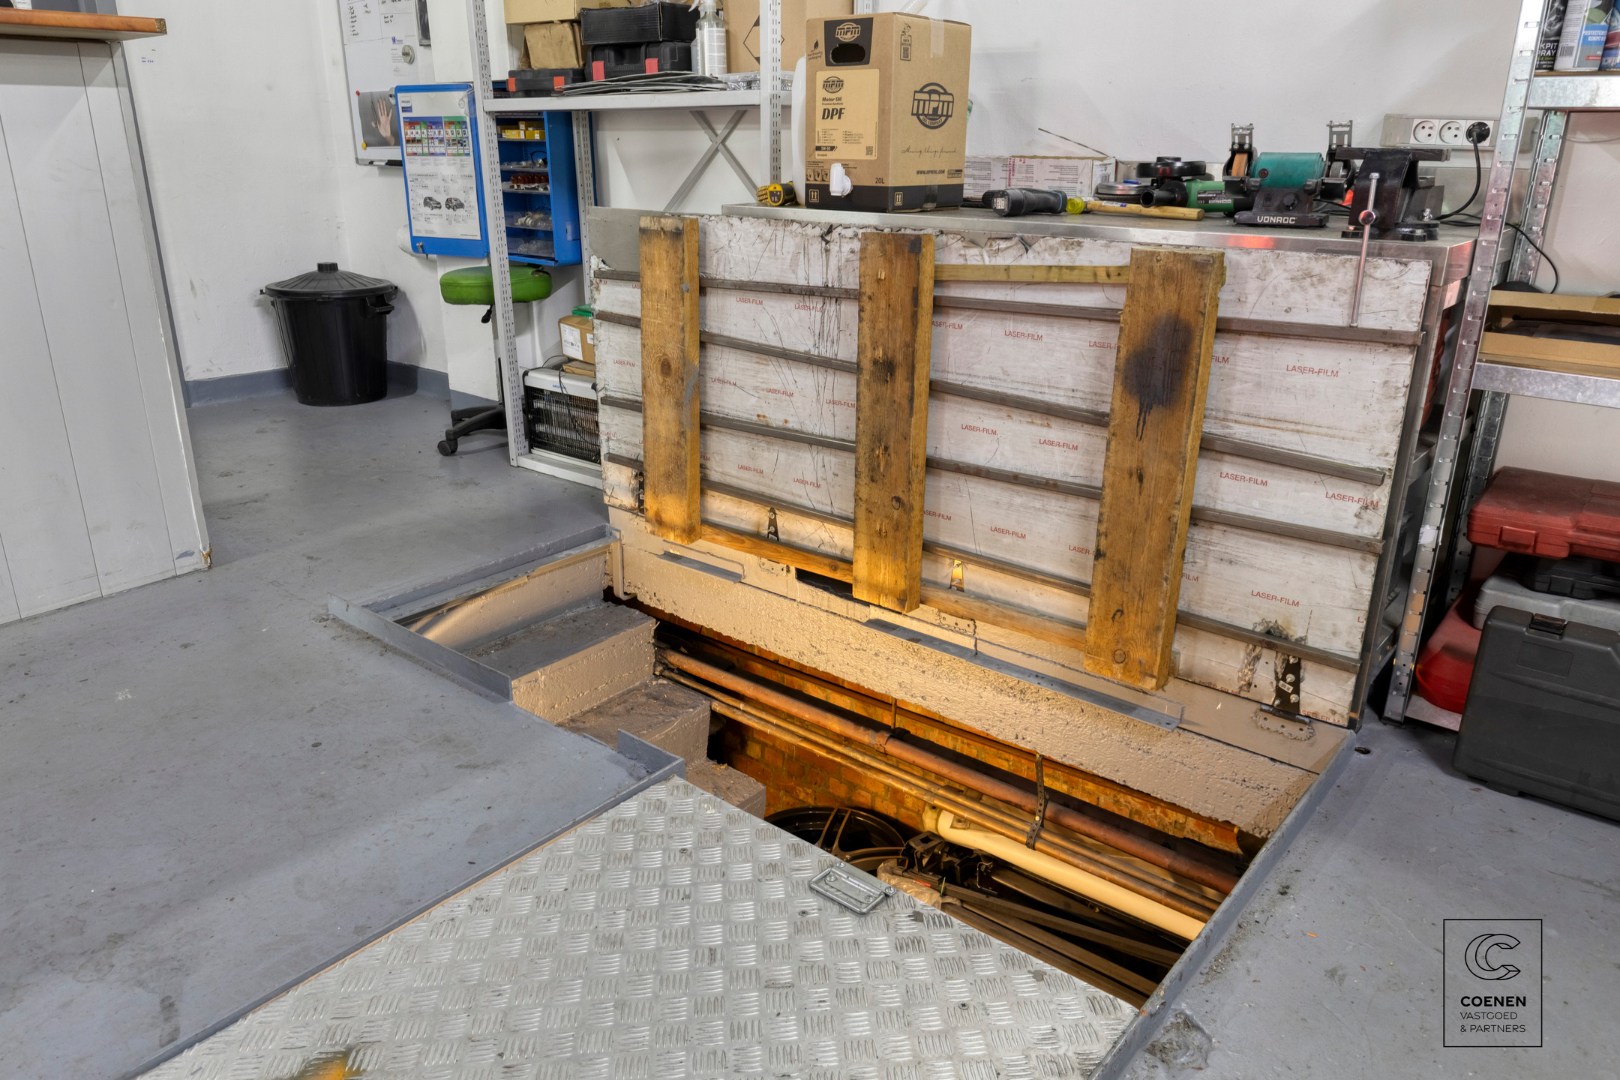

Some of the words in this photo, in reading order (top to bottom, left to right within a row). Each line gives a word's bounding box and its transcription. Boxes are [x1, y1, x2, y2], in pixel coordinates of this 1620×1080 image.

[821, 107, 846, 120] DPF
[1257, 216, 1296, 224] VONROC
[735, 297, 764, 306] LASER-FILM
[931, 320, 963, 330] ASER-FILM
[1004, 330, 1043, 341] LASER-FILM
[1088, 340, 1117, 350] LASER-F
[1286, 364, 1339, 378] LASER-FILM
[765, 387, 794, 398] LASER-FILM
[825, 398, 856, 409] LASER-FILM
[961, 423, 998, 436] LASER-FILM
[1038, 438, 1079, 451] LASER-FILM
[1219, 472, 1268, 486] LASER-FILM
[1325, 491, 1380, 508] LASER-FILM
[923, 509, 952, 521] ASER-FILM
[990, 526, 1027, 540] LASER-FILM
[1068, 544, 1095, 556] LASER-
[1251, 590, 1300, 607] LASER-FILM
